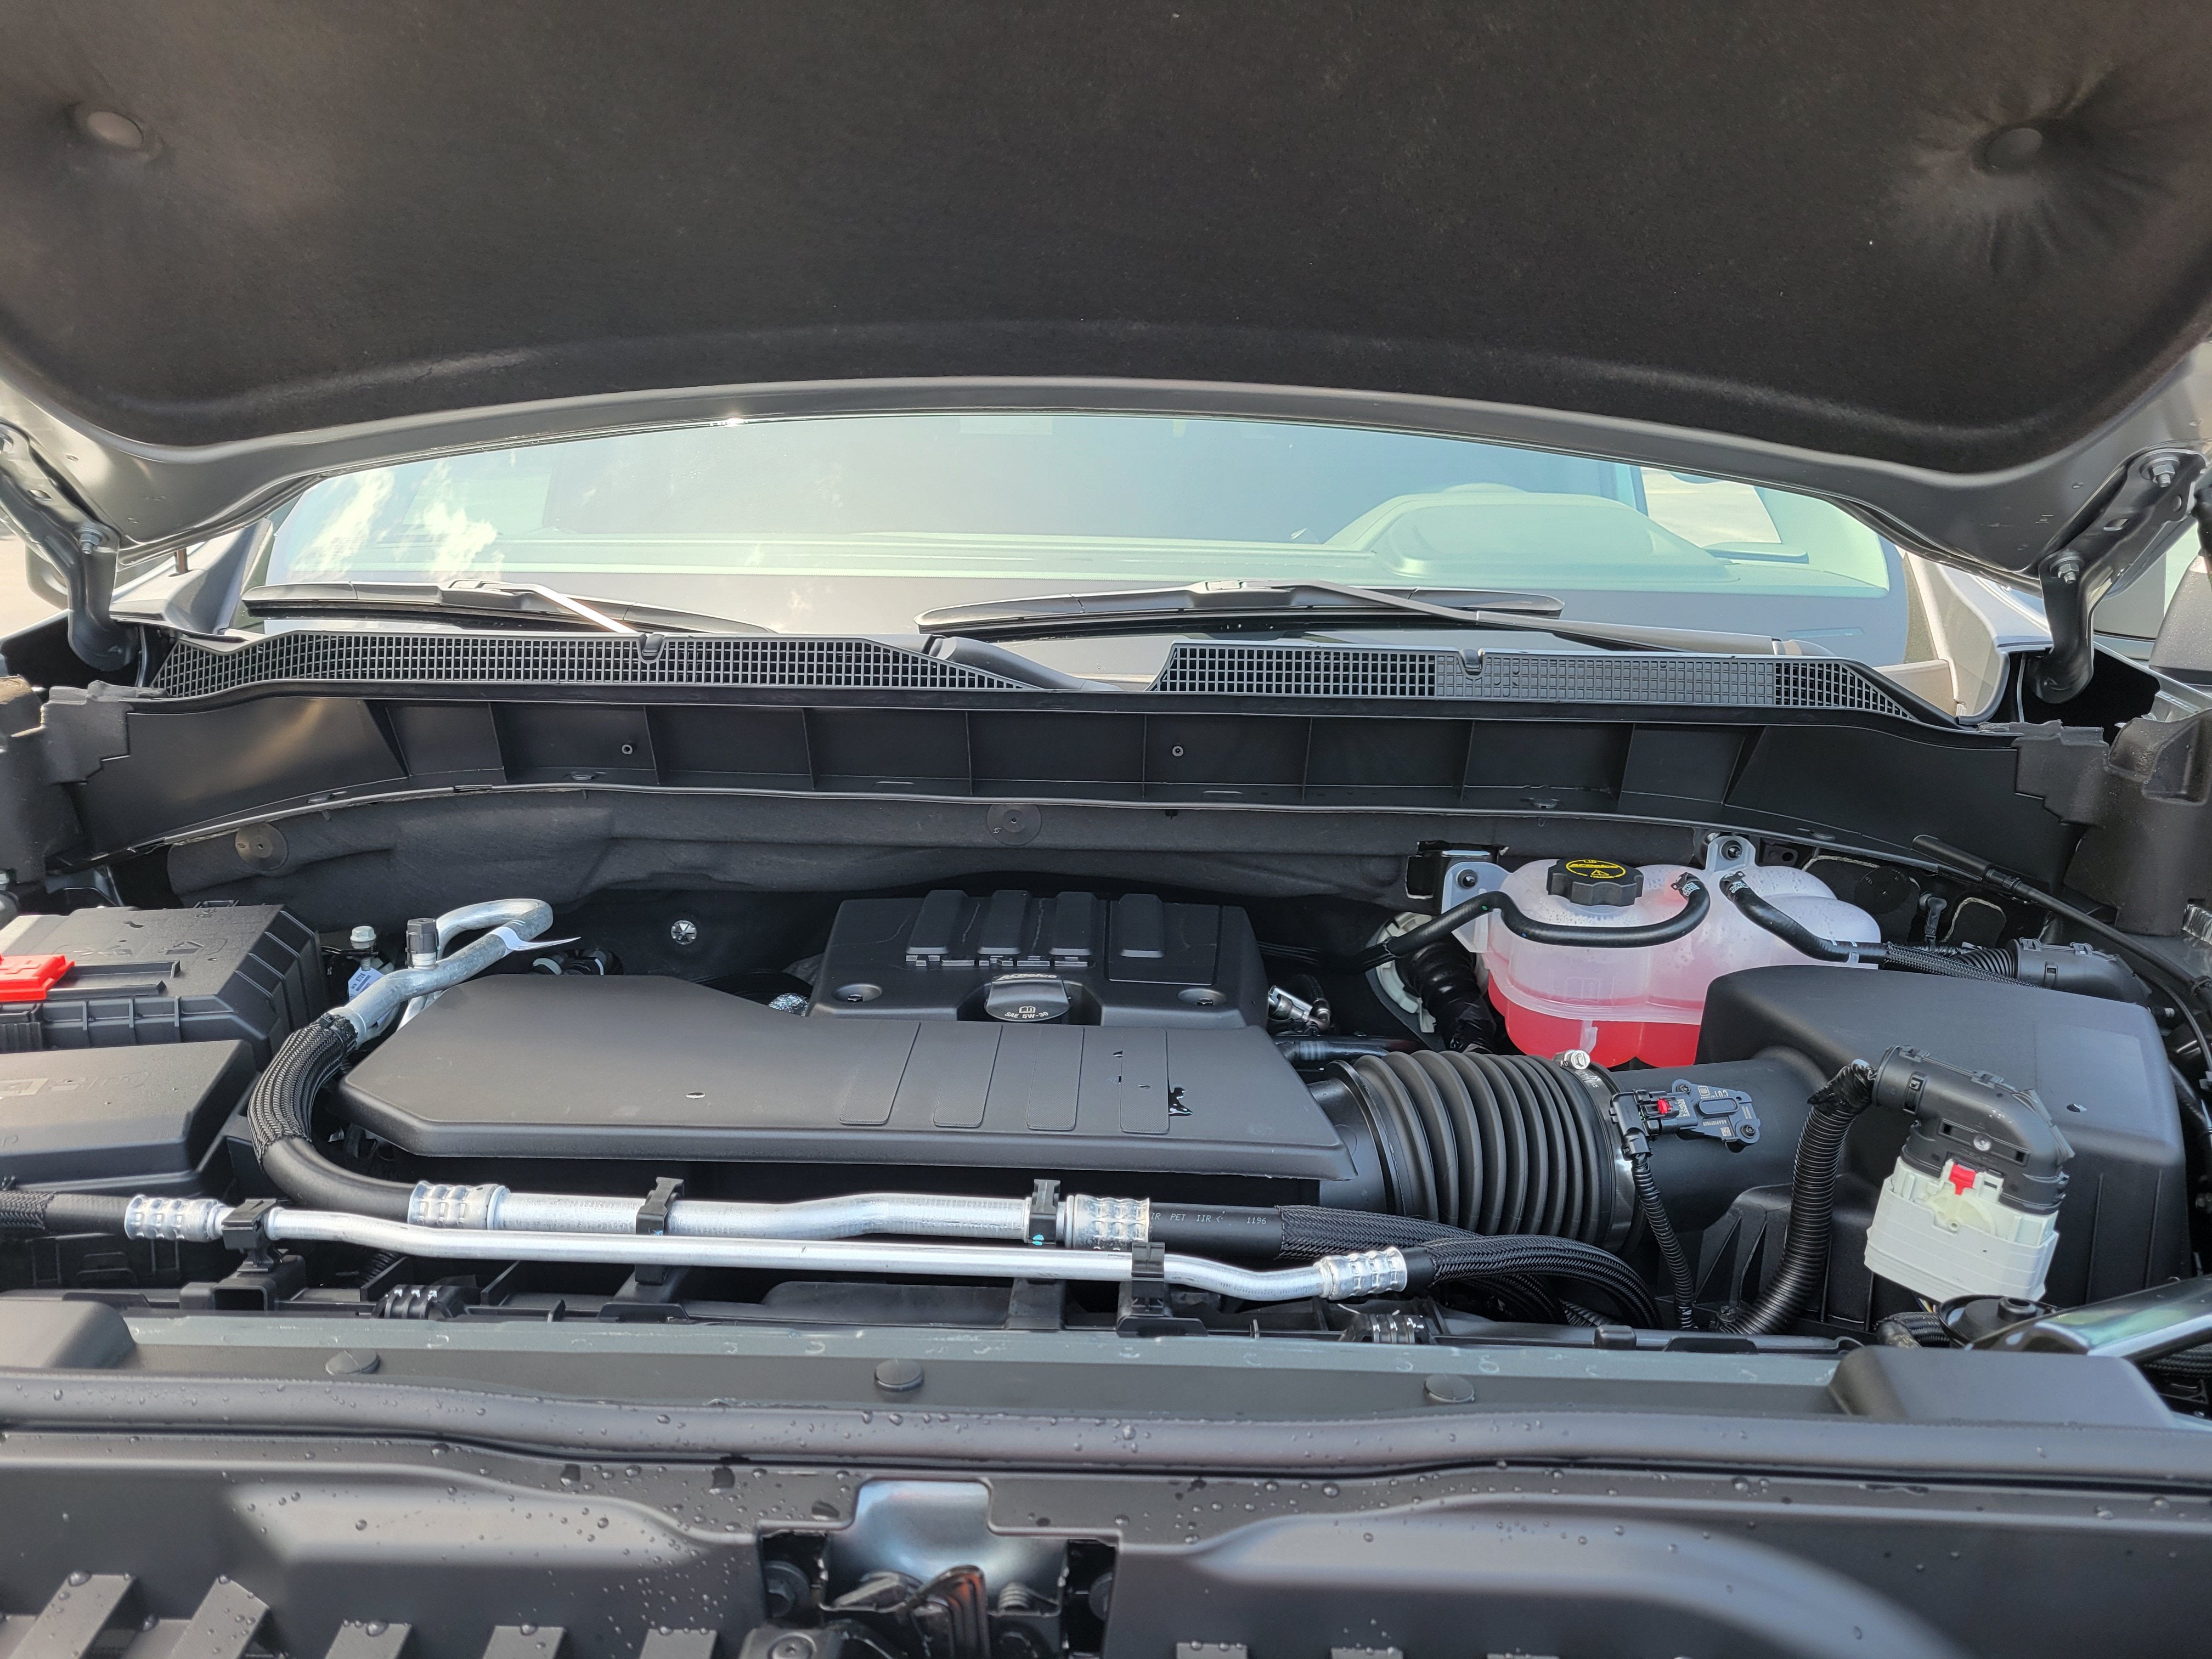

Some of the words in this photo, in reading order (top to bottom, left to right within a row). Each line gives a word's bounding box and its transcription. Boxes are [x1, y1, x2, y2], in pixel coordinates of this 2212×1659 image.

[1170, 1213, 1187, 1221] PET
[1196, 1214, 1212, 1223] IIR
[1246, 1216, 1267, 1224] 1196
